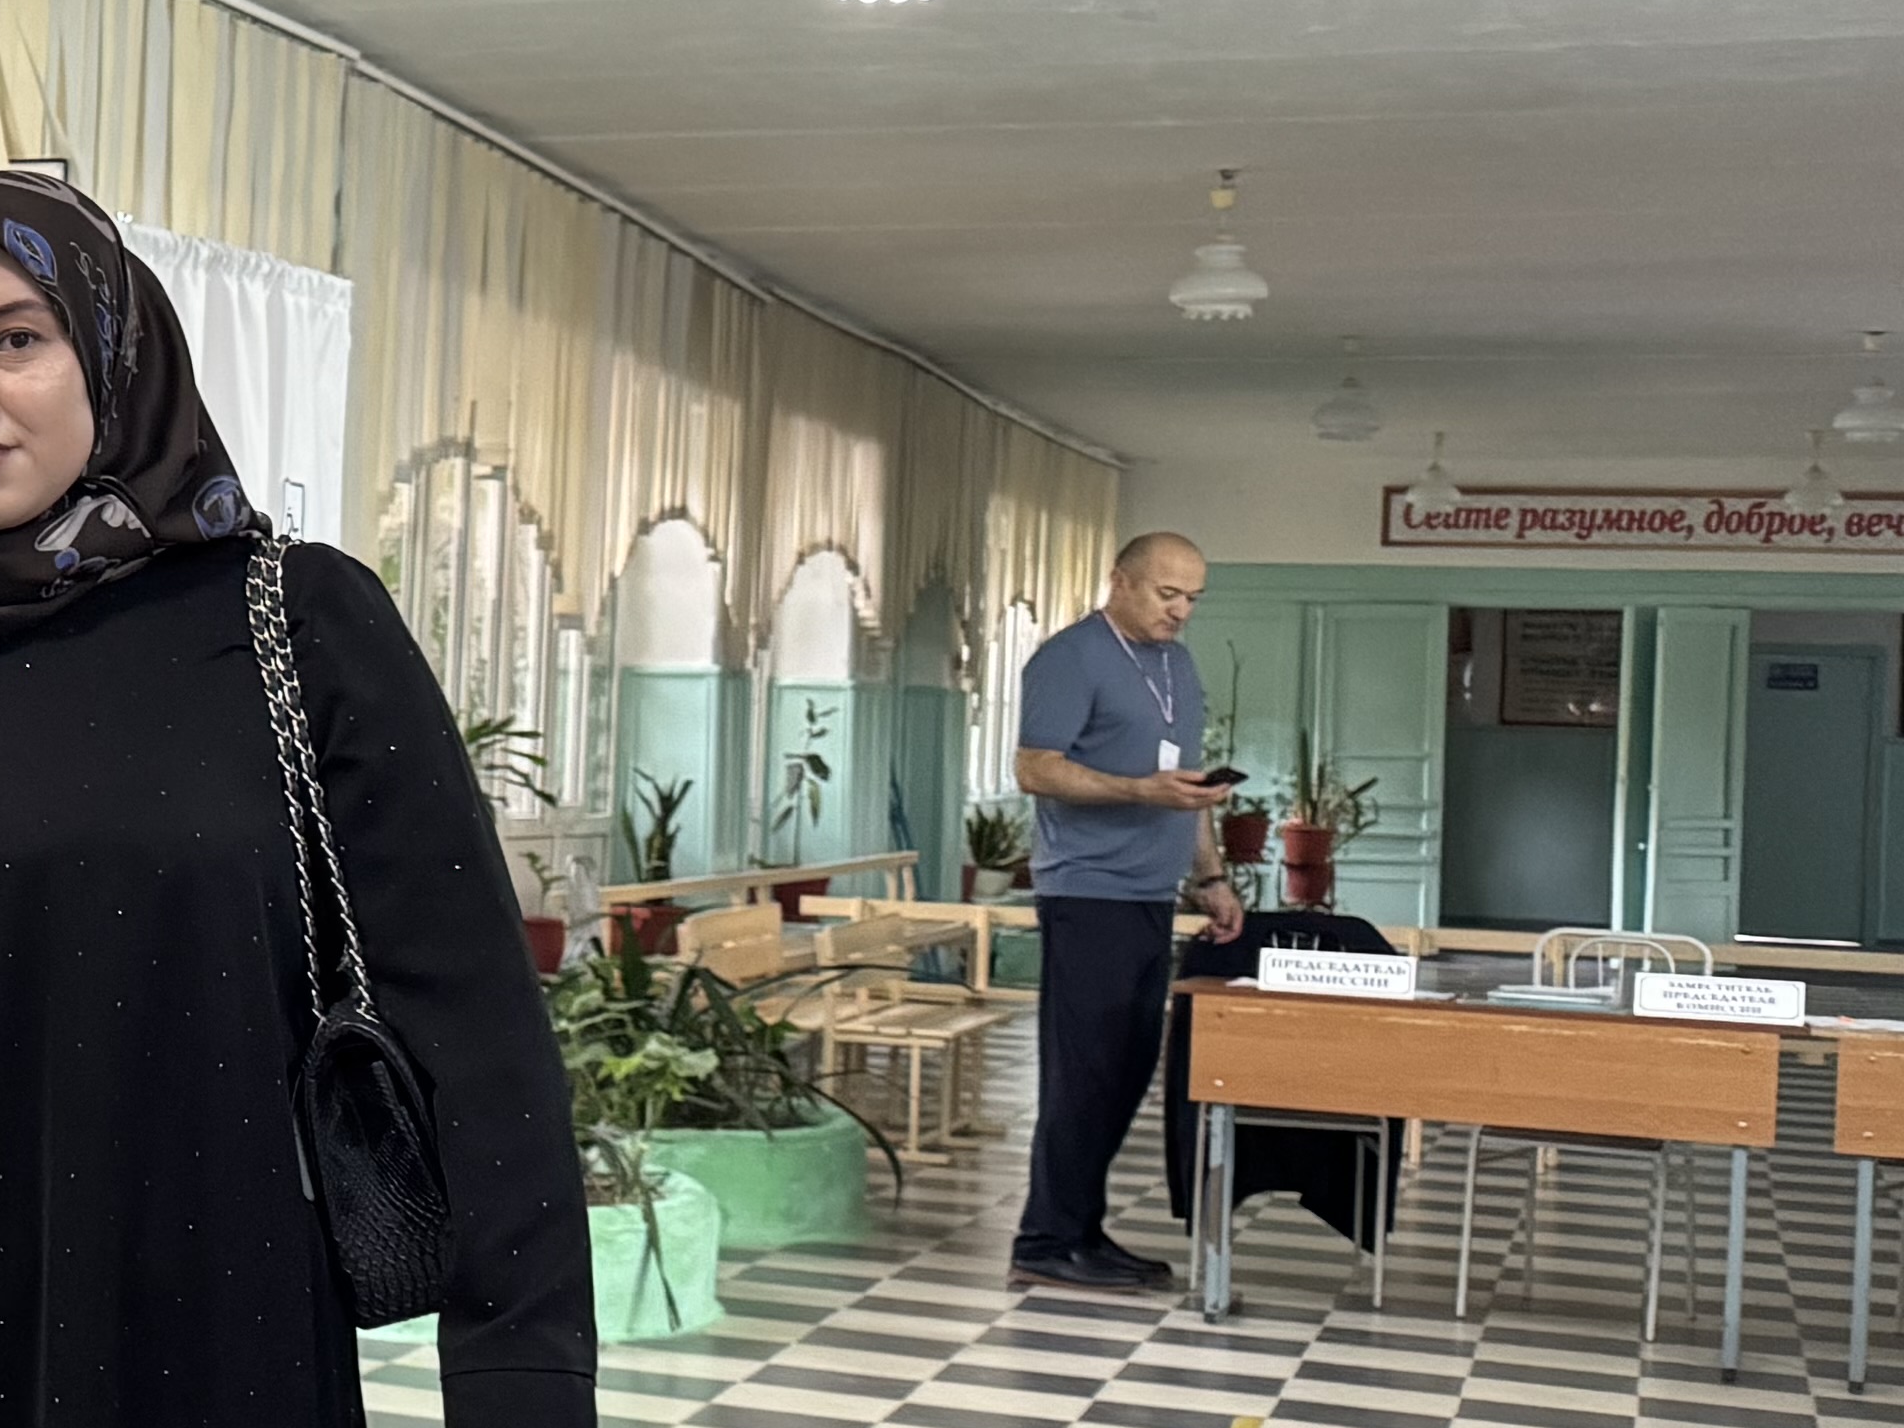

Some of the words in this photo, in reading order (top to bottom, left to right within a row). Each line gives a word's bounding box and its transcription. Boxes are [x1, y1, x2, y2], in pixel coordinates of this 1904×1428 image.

[1515, 506, 1695, 541] разумное,
[1704, 498, 1835, 544] доброе,
[1271, 958, 1406, 975] ПРЕДСЕДАТЕЛЬ
[1286, 973, 1390, 988] КОМИССИИ
[1662, 990, 1777, 1005] ПРЕДСЕДАТЕЛЯ
